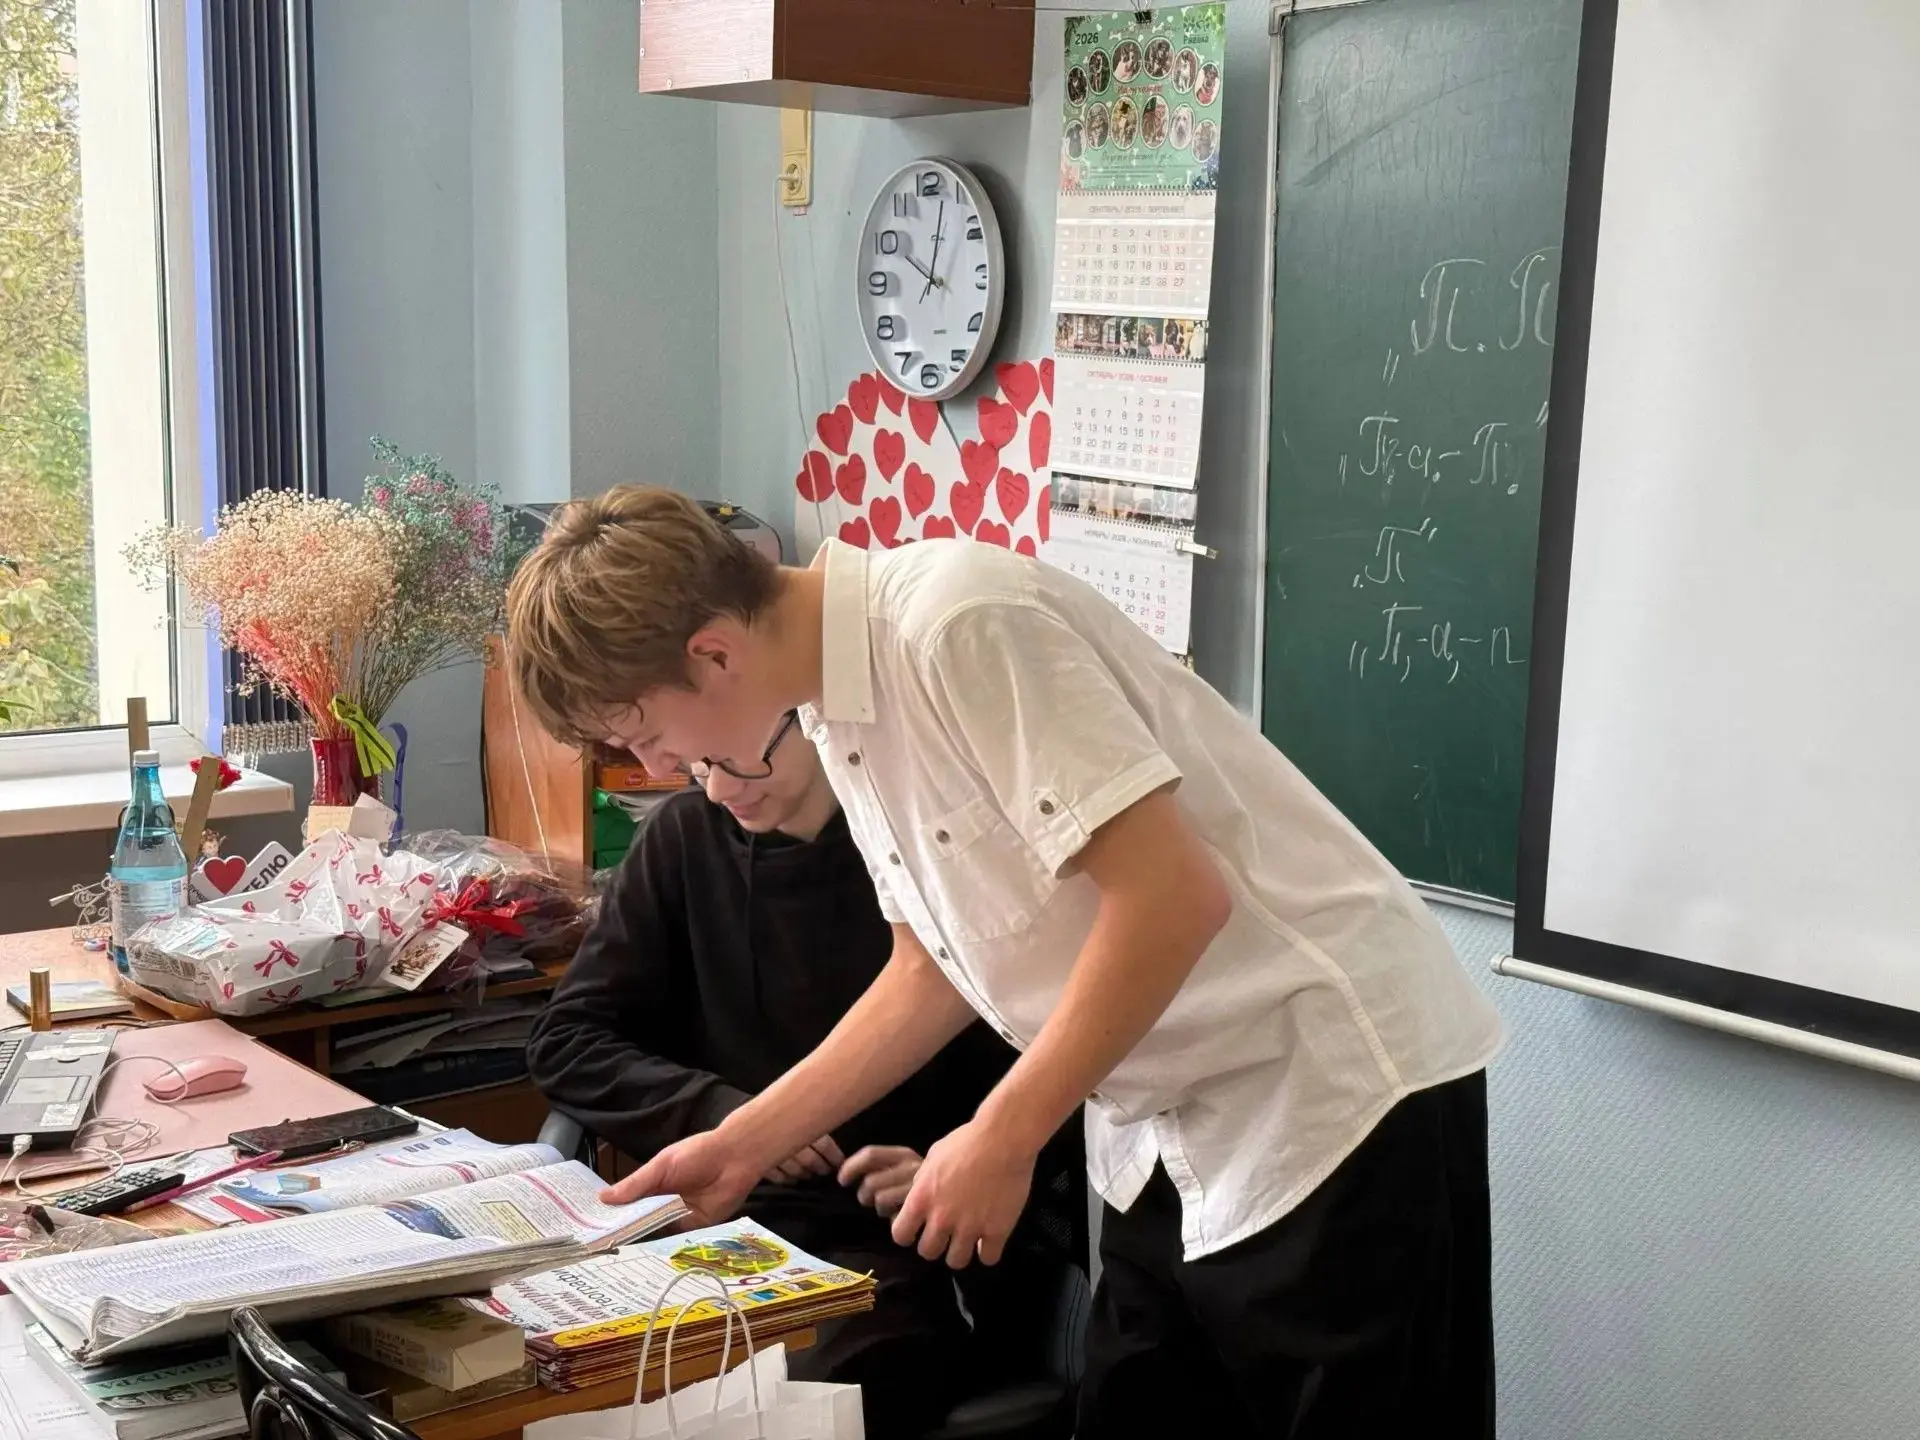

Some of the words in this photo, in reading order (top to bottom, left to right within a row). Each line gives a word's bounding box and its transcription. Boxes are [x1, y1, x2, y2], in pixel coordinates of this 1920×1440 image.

[1075, 33, 1099, 46] 2026
[916, 171, 941, 197] 12
[894, 193, 907, 217] 11
[875, 230, 899, 256] 10
[869, 271, 888, 297] 9
[877, 315, 895, 341] 8
[894, 352, 912, 376] 7
[920, 364, 940, 389] 6
[1123, 397, 1126, 405] 1
[1139, 397, 1143, 406] 2
[1154, 399, 1159, 407] 3
[1171, 400, 1176, 408] 4
[1091, 409, 1096, 417] 6
[1107, 410, 1111, 418] 7
[1122, 411, 1127, 420] 8
[1137, 412, 1143, 422] 9
[1152, 414, 1161, 423] 10
[1168, 416, 1176, 425] 11
[1074, 421, 1082, 431] 12
[1089, 423, 1097, 432] 13
[1104, 425, 1112, 435] 14
[1120, 426, 1128, 435] 15
[1135, 428, 1143, 437] 16
[1151, 429, 1159, 439] 17
[1073, 436, 1081, 446] 19
[1087, 438, 1096, 448] 20
[1102, 440, 1111, 449] 21
[1117, 441, 1127, 451] 22
[1133, 443, 1142, 453] 23
[1148, 445, 1158, 455] 24
[1084, 453, 1094, 463] 27
[1071, 562, 1075, 571] 2
[1084, 566, 1089, 574] 3
[1099, 569, 1104, 577] 4
[1114, 571, 1119, 580] 5
[1129, 574, 1134, 583] 6
[1145, 576, 1149, 585] 7
[1161, 565, 1165, 573] 1
[1112, 586, 1120, 595] 12
[1126, 589, 1135, 598] 13
[1125, 604, 1135, 613] 20
[1140, 607, 1149, 616] 21
[1156, 610, 1165, 619] 22
[1155, 624, 1165, 634] 29
[610, 1305, 635, 1317] по
